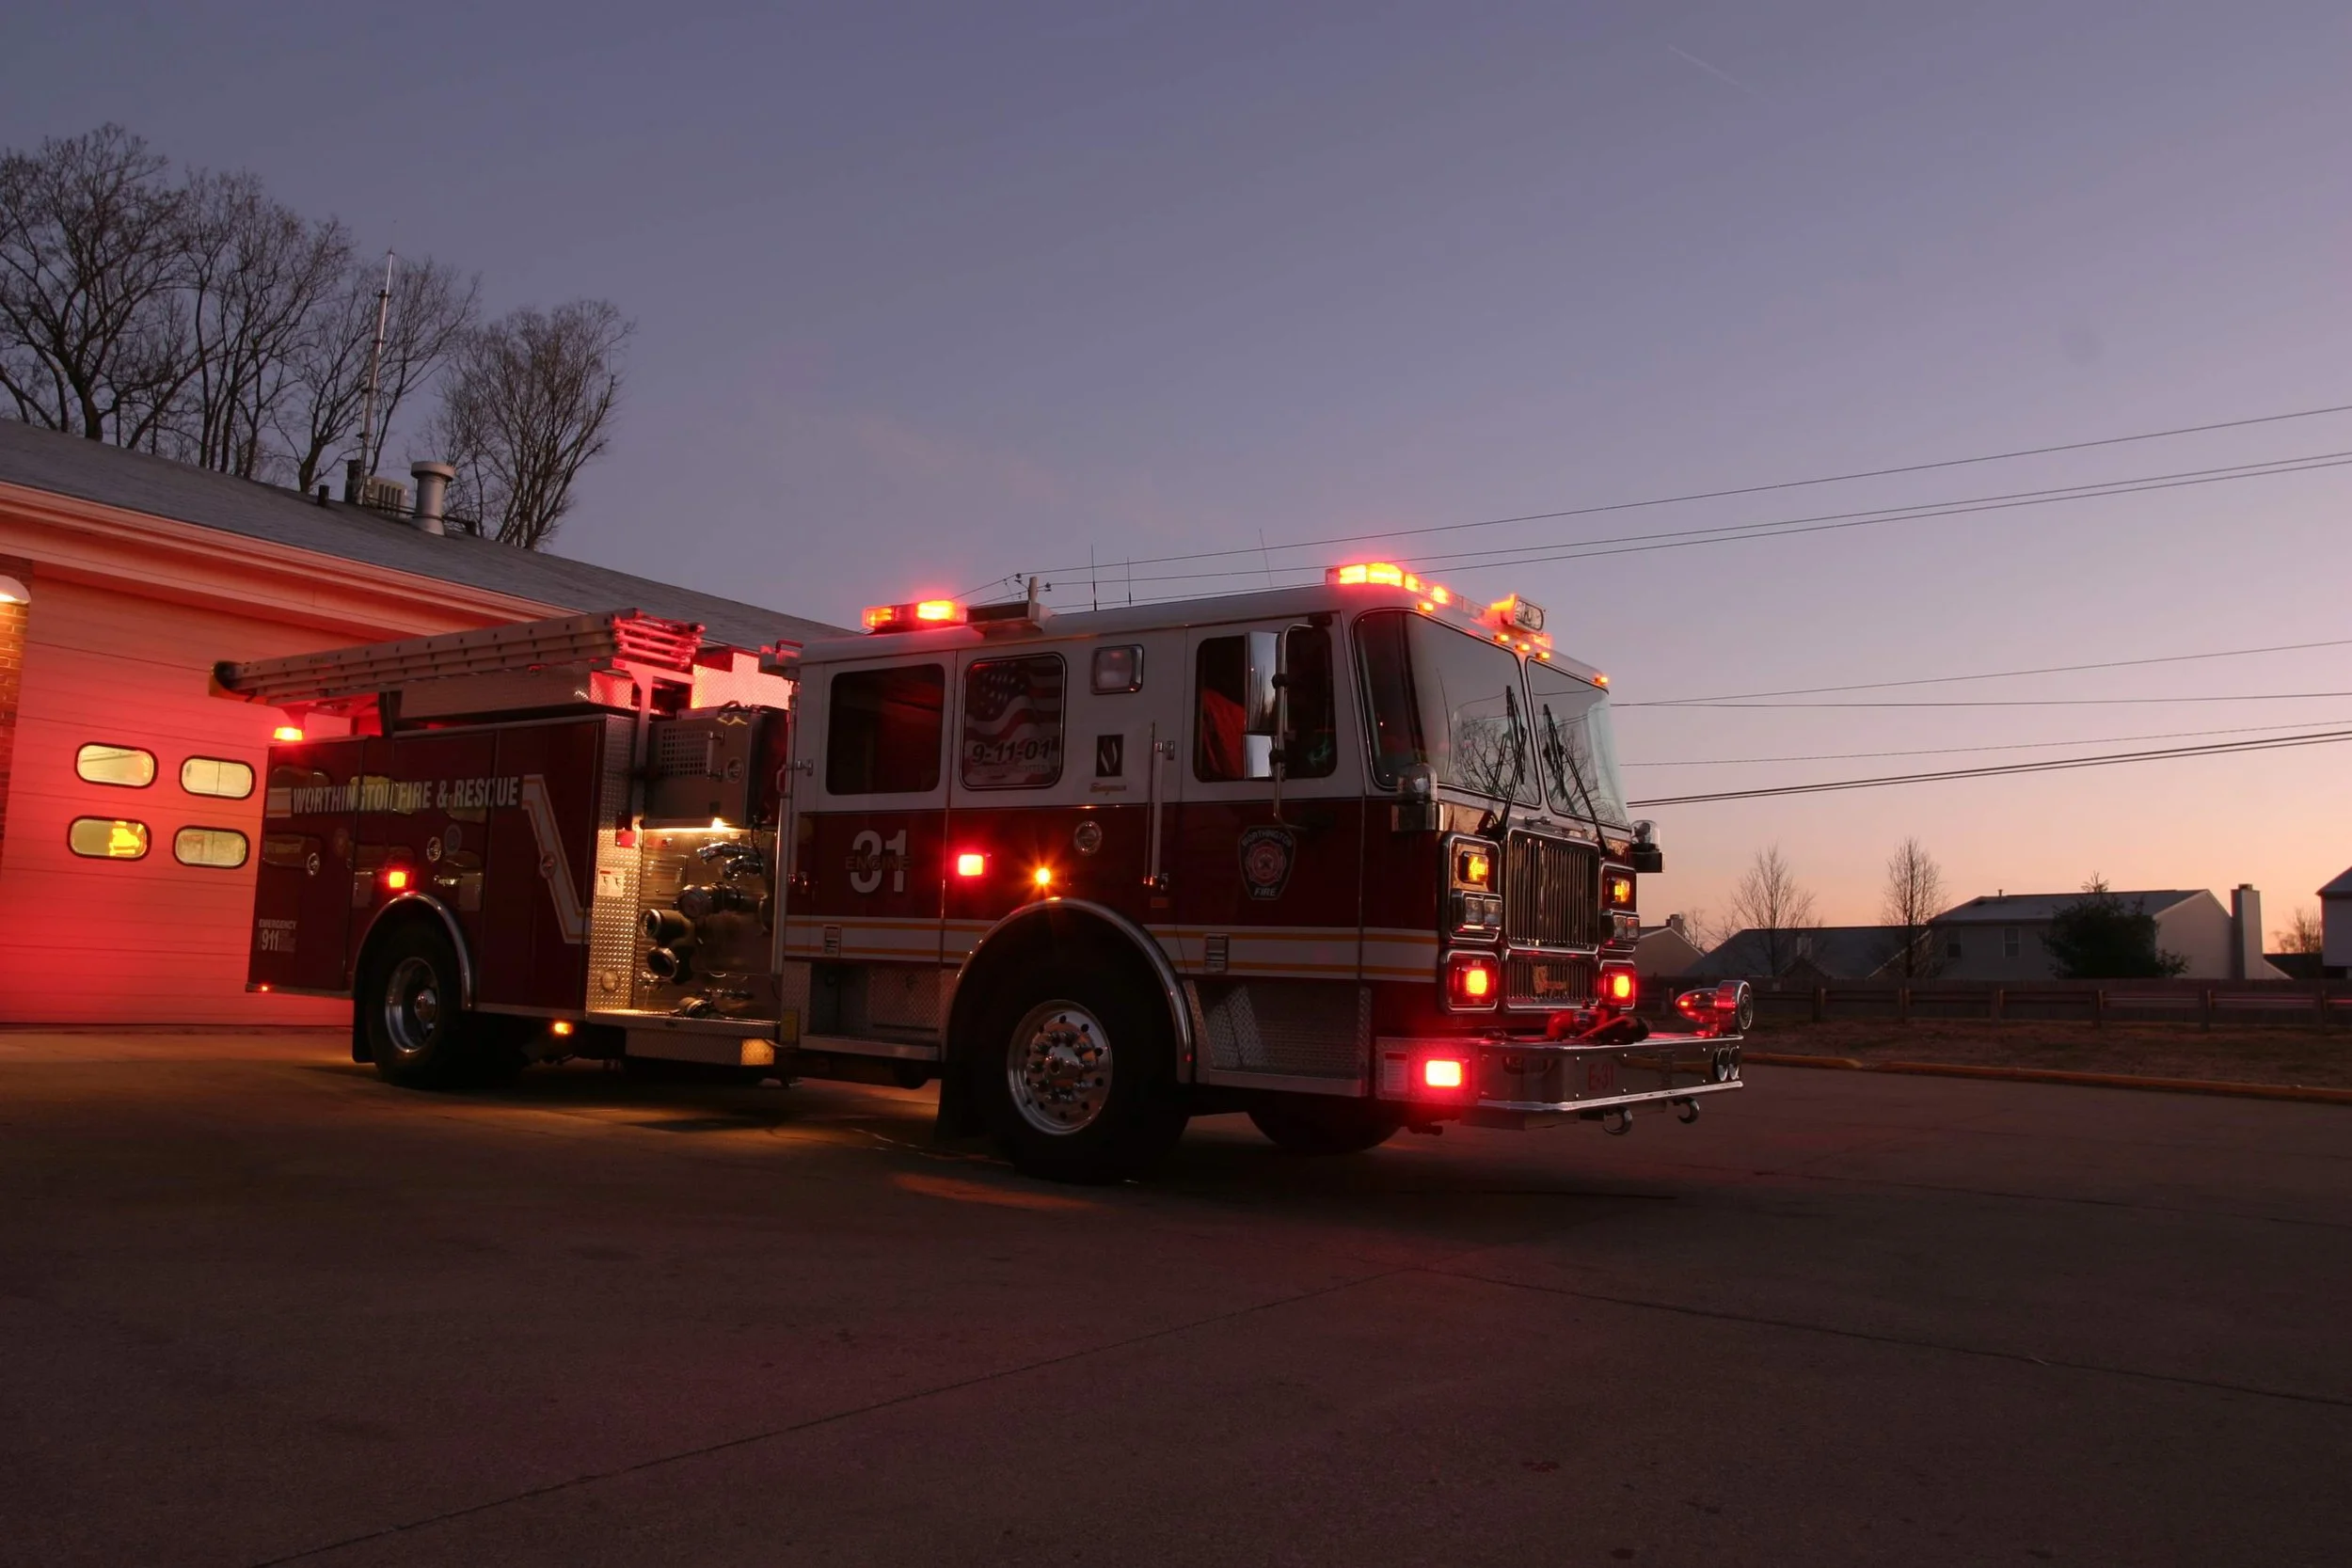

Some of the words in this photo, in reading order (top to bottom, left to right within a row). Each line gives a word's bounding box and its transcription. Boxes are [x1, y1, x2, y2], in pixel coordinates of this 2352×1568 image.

[397, 780, 432, 810] FIRE
[437, 779, 449, 808] &
[453, 776, 518, 807] RESCUE
[845, 854, 911, 870] ENGINE
[850, 830, 907, 893] 31
[1254, 887, 1277, 897] FIRE
[261, 928, 280, 951] 911
